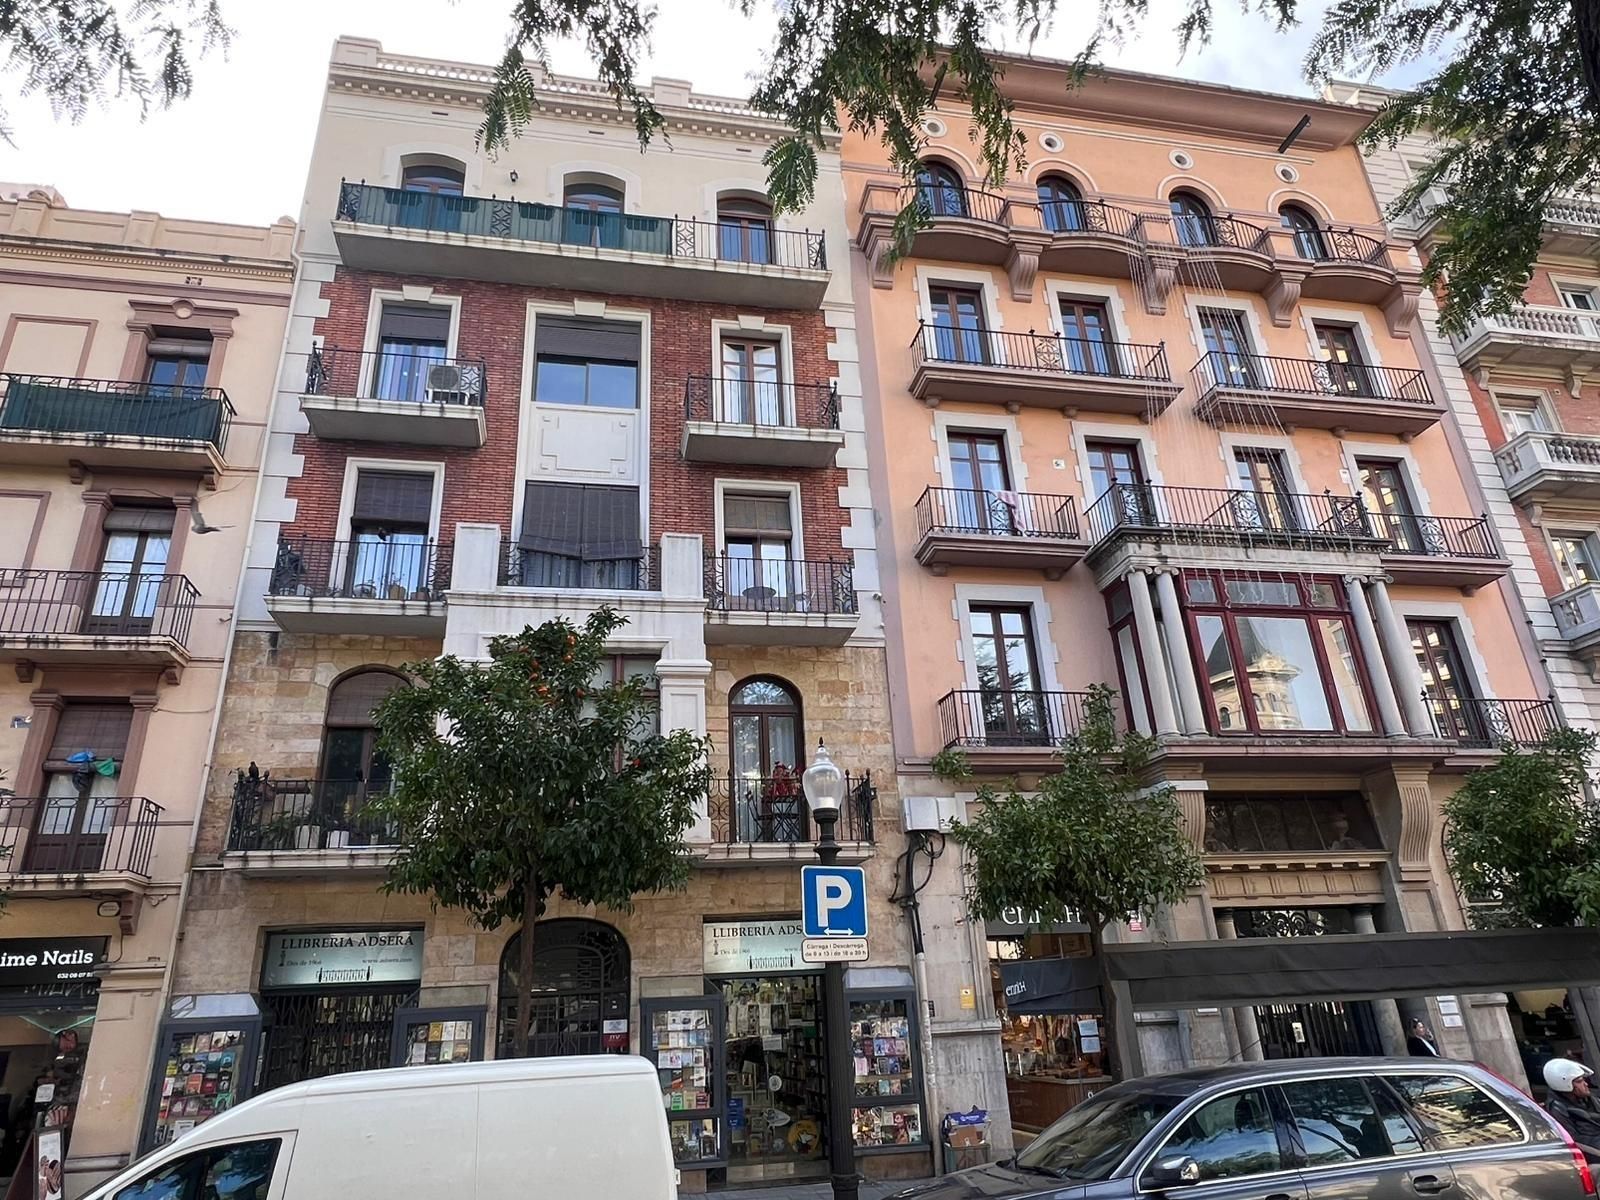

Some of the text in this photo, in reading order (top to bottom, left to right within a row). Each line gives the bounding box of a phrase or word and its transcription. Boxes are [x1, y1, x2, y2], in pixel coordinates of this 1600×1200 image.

[815, 875, 852, 927] P
[713, 925, 803, 937] LLIBRERIA ADS
[281, 937, 353, 949] LLIBRERIA
[41, 949, 94, 966] Nails
